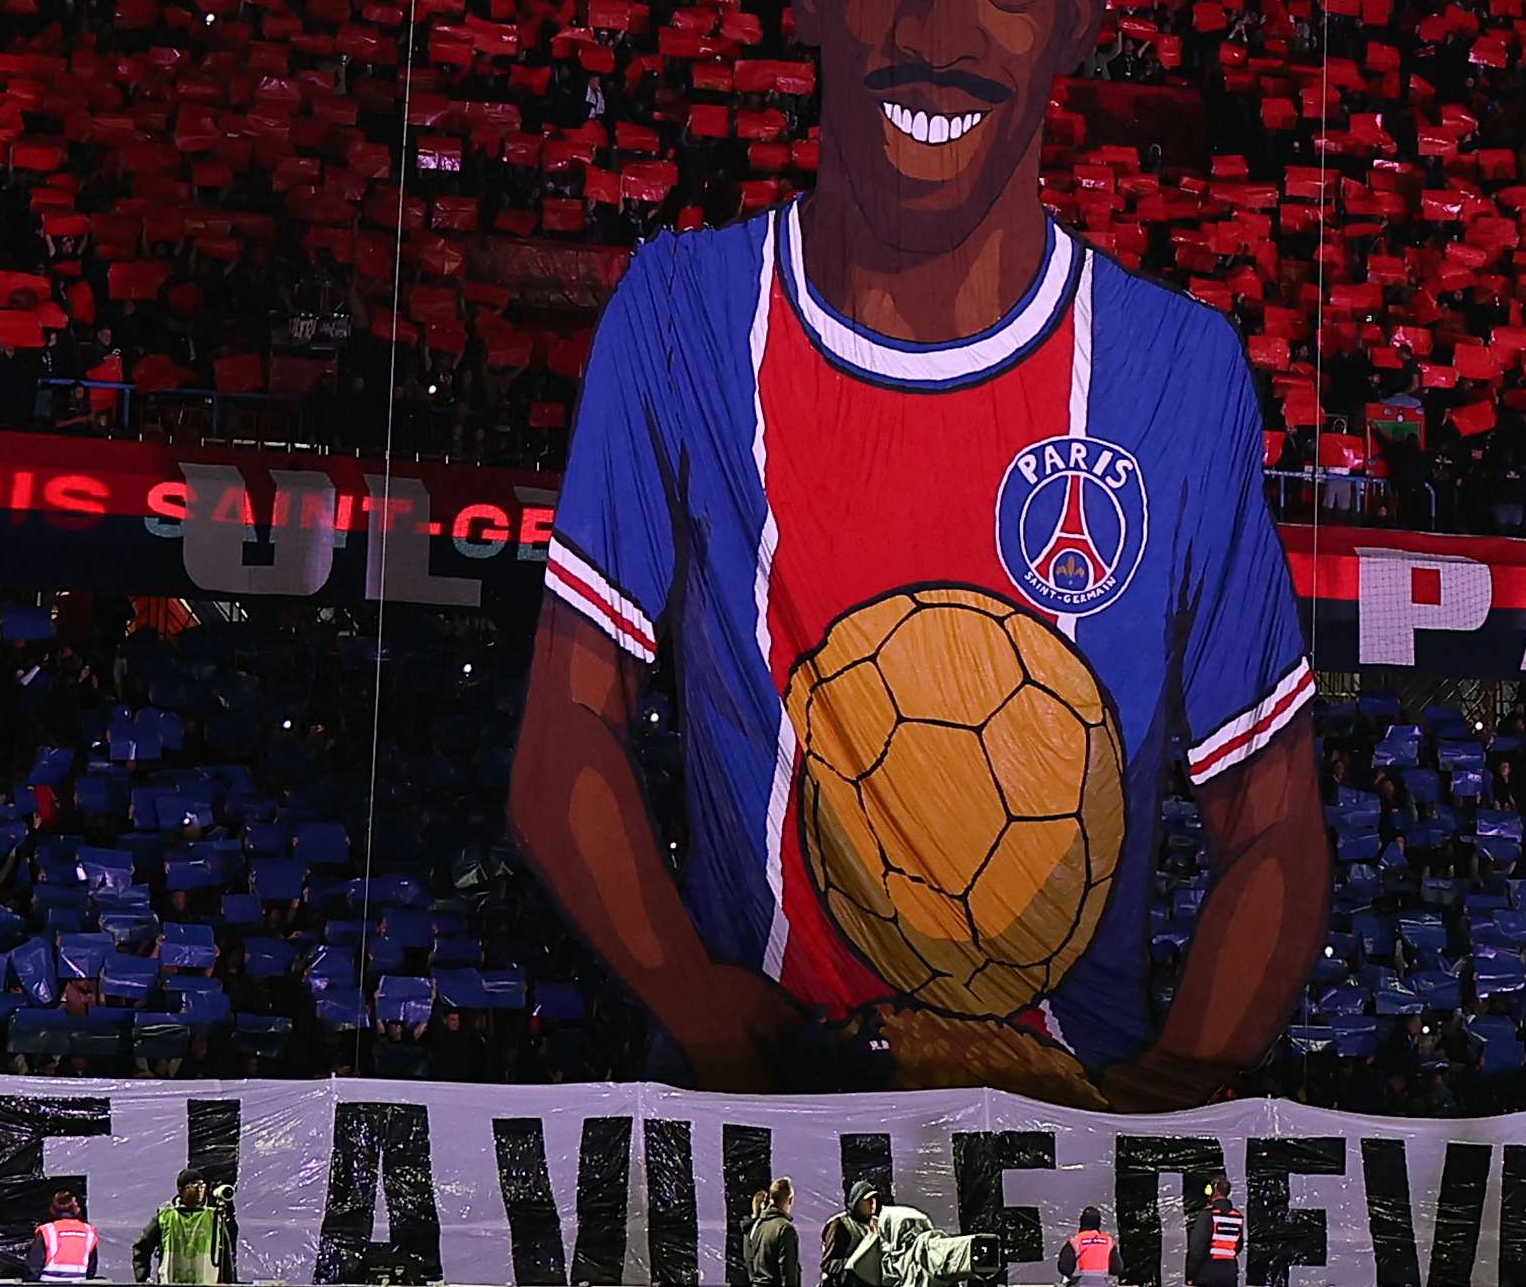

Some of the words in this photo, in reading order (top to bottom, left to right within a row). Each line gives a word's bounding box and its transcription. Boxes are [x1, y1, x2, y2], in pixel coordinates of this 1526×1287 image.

[1017, 442, 1134, 489] PARIS
[178, 461, 559, 608] UL
[1023, 570, 1118, 605] SAINT-GERMAIN
